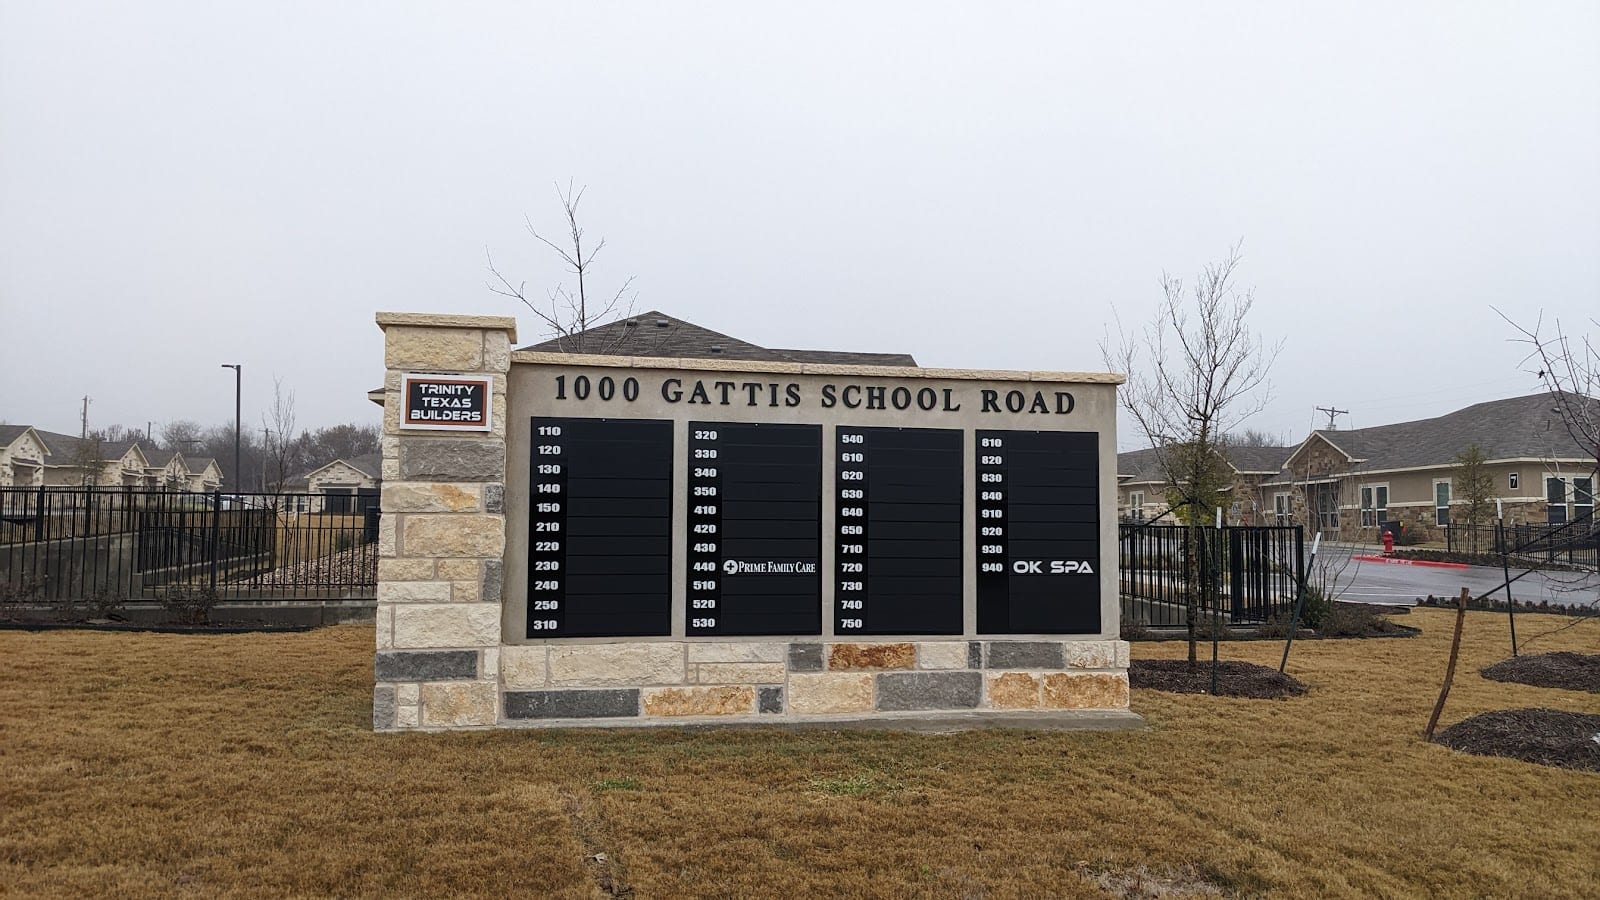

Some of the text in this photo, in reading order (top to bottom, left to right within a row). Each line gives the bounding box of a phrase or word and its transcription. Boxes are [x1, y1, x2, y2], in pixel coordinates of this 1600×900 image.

[419, 384, 475, 395] TRINITY
[555, 375, 1075, 415] 1000 GATTIS SCHOOL ROAD
[421, 397, 472, 408] TEXAS
[410, 409, 482, 421] BUILDERS
[537, 426, 562, 436] 110
[694, 430, 718, 441] 320
[841, 434, 864, 444] 540
[981, 437, 1003, 448] 810
[537, 445, 562, 455] 120
[694, 448, 718, 459] 330
[841, 452, 864, 463] 610
[981, 455, 1003, 465] 820
[537, 464, 561, 474] 130
[694, 467, 717, 478] 340
[841, 470, 864, 481] 620
[981, 473, 1003, 483] 830
[536, 483, 561, 494] 140
[693, 486, 717, 497] 350
[841, 489, 864, 499] 630
[981, 491, 1003, 501] 840
[536, 502, 561, 513] 150
[693, 505, 717, 515] 410
[841, 507, 864, 517] 640
[981, 508, 1003, 519] 910
[535, 521, 560, 532] 210
[693, 524, 717, 534] 420
[841, 525, 863, 535] 650
[981, 526, 1003, 536] 920
[535, 541, 560, 552] 220
[693, 542, 717, 553] 430
[841, 544, 863, 554] 710
[981, 544, 1003, 554] 930
[535, 560, 560, 571] 230
[693, 560, 816, 573] 440 PRIME FAMILY CARE
[841, 562, 863, 573] 720
[981, 560, 1094, 574] 940 OK SPA
[534, 580, 559, 591] 240
[693, 580, 716, 591] 510
[841, 581, 863, 591] 730
[534, 600, 559, 611] 250
[692, 599, 716, 609] 520
[840, 599, 863, 610] 740
[533, 619, 558, 630] 310
[692, 617, 716, 628] 530
[840, 618, 863, 629] 750
